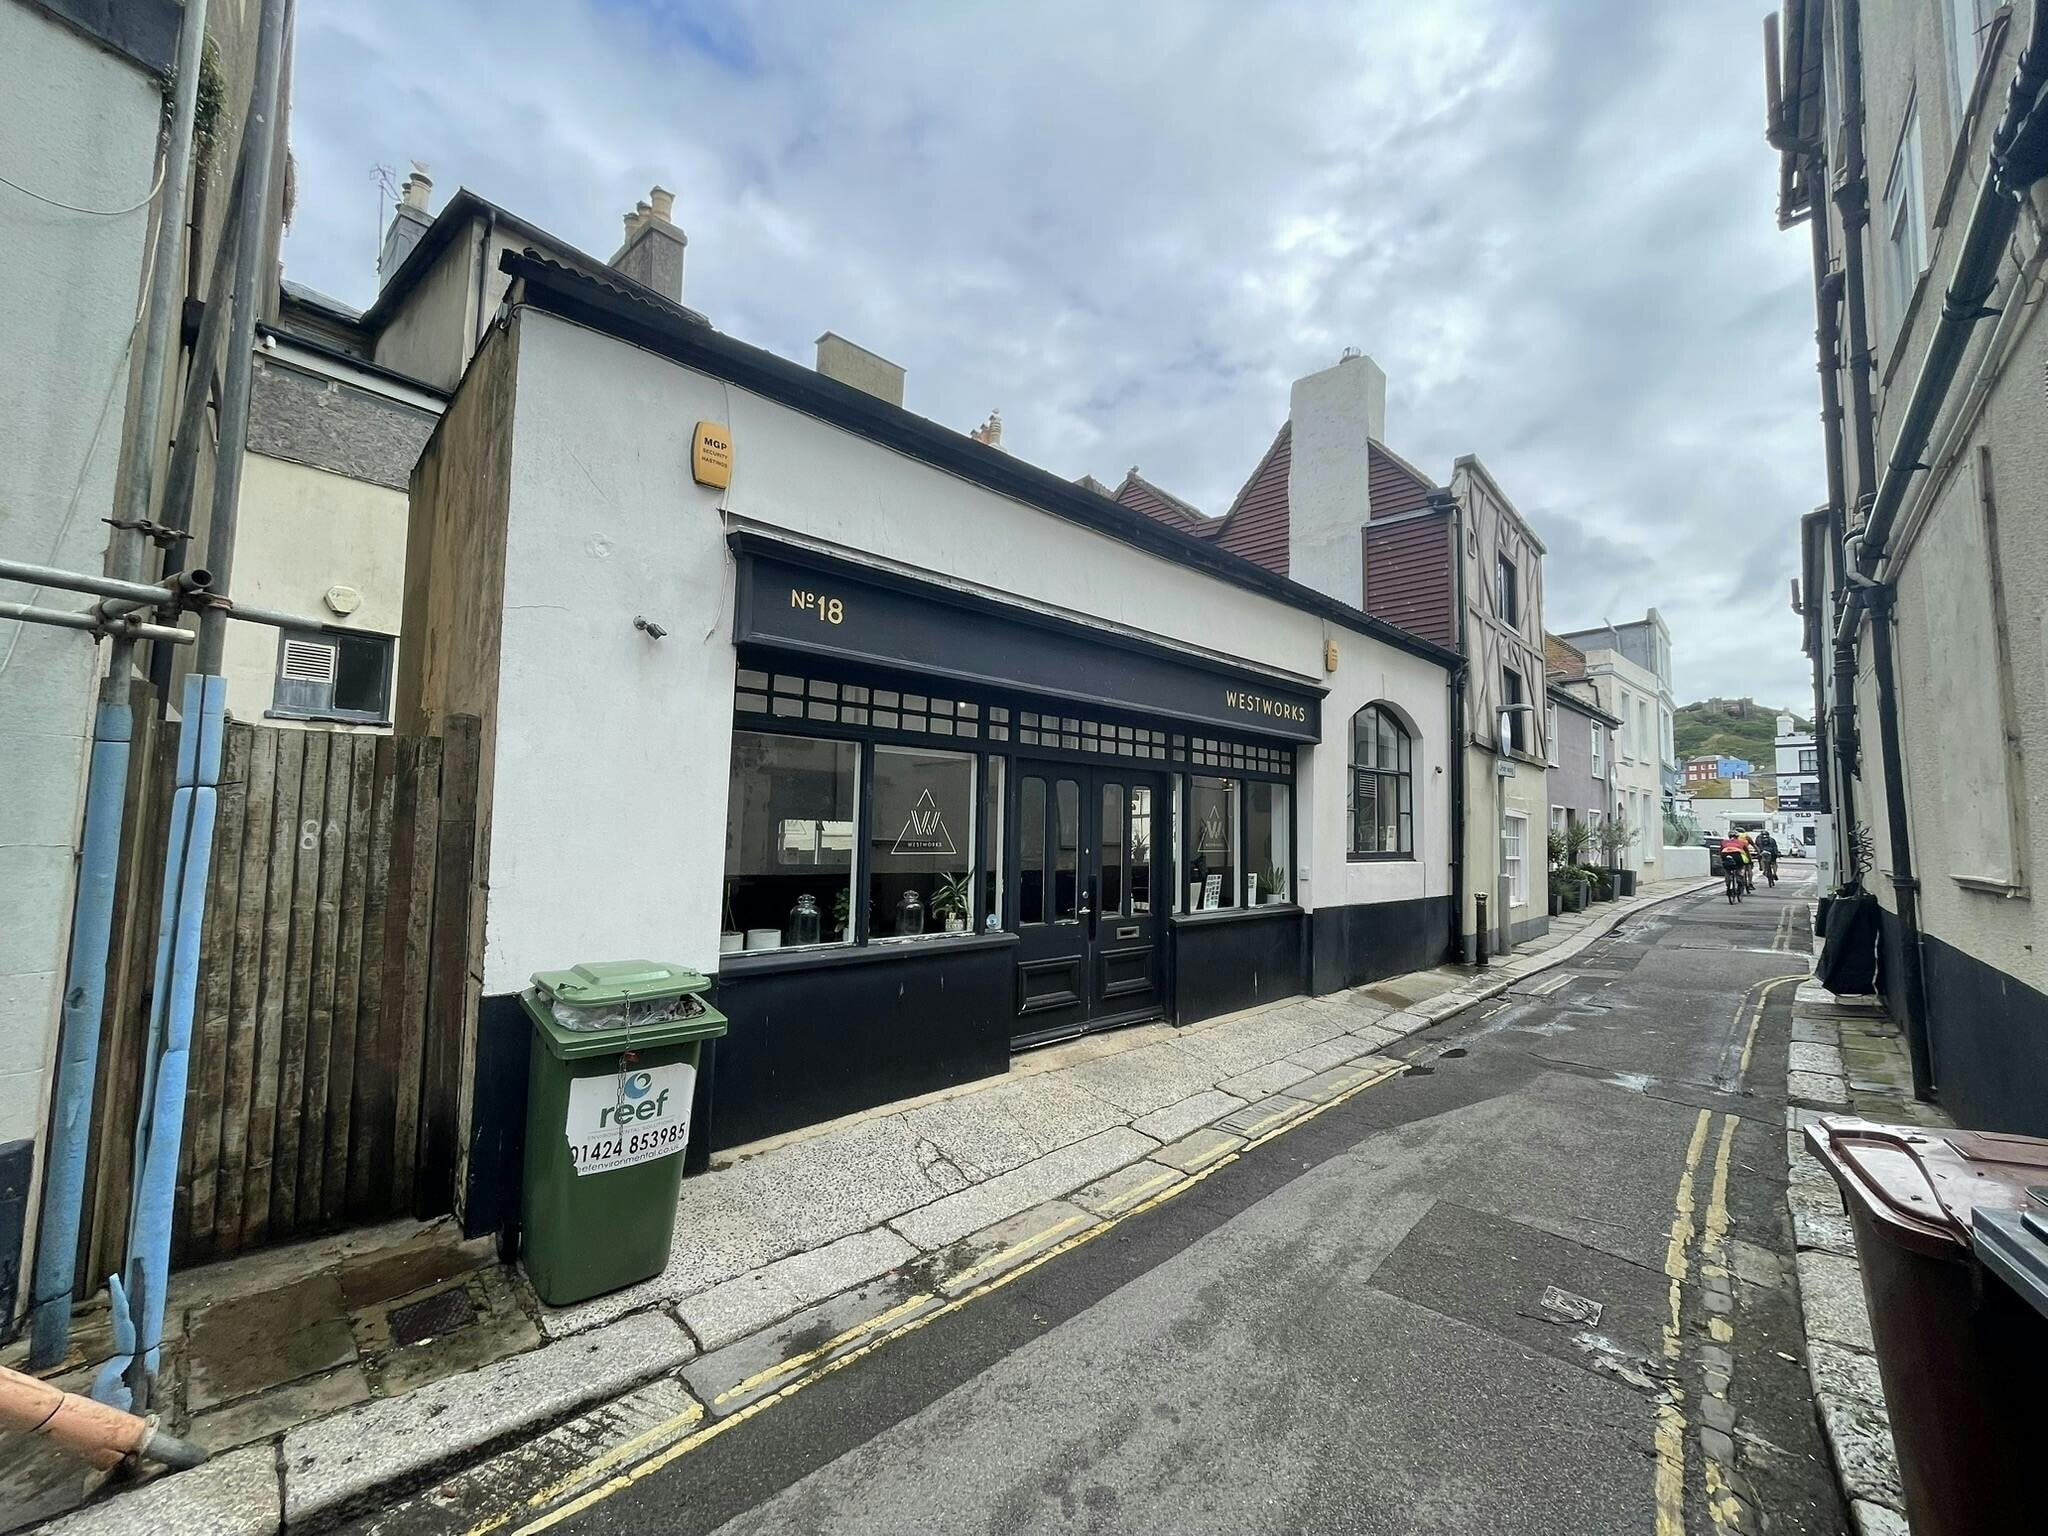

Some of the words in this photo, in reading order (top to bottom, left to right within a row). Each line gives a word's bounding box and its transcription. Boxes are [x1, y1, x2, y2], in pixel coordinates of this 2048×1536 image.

[702, 447, 728, 460] SECURITY
[704, 437, 728, 450] MGP
[701, 456, 728, 469] HASTINGS
[1226, 690, 1305, 722] WESTWORKS
[600, 1088, 669, 1128] reef
[629, 1121, 686, 1154] 853985
[578, 1144, 680, 1173] efenvironmental.co.uk
